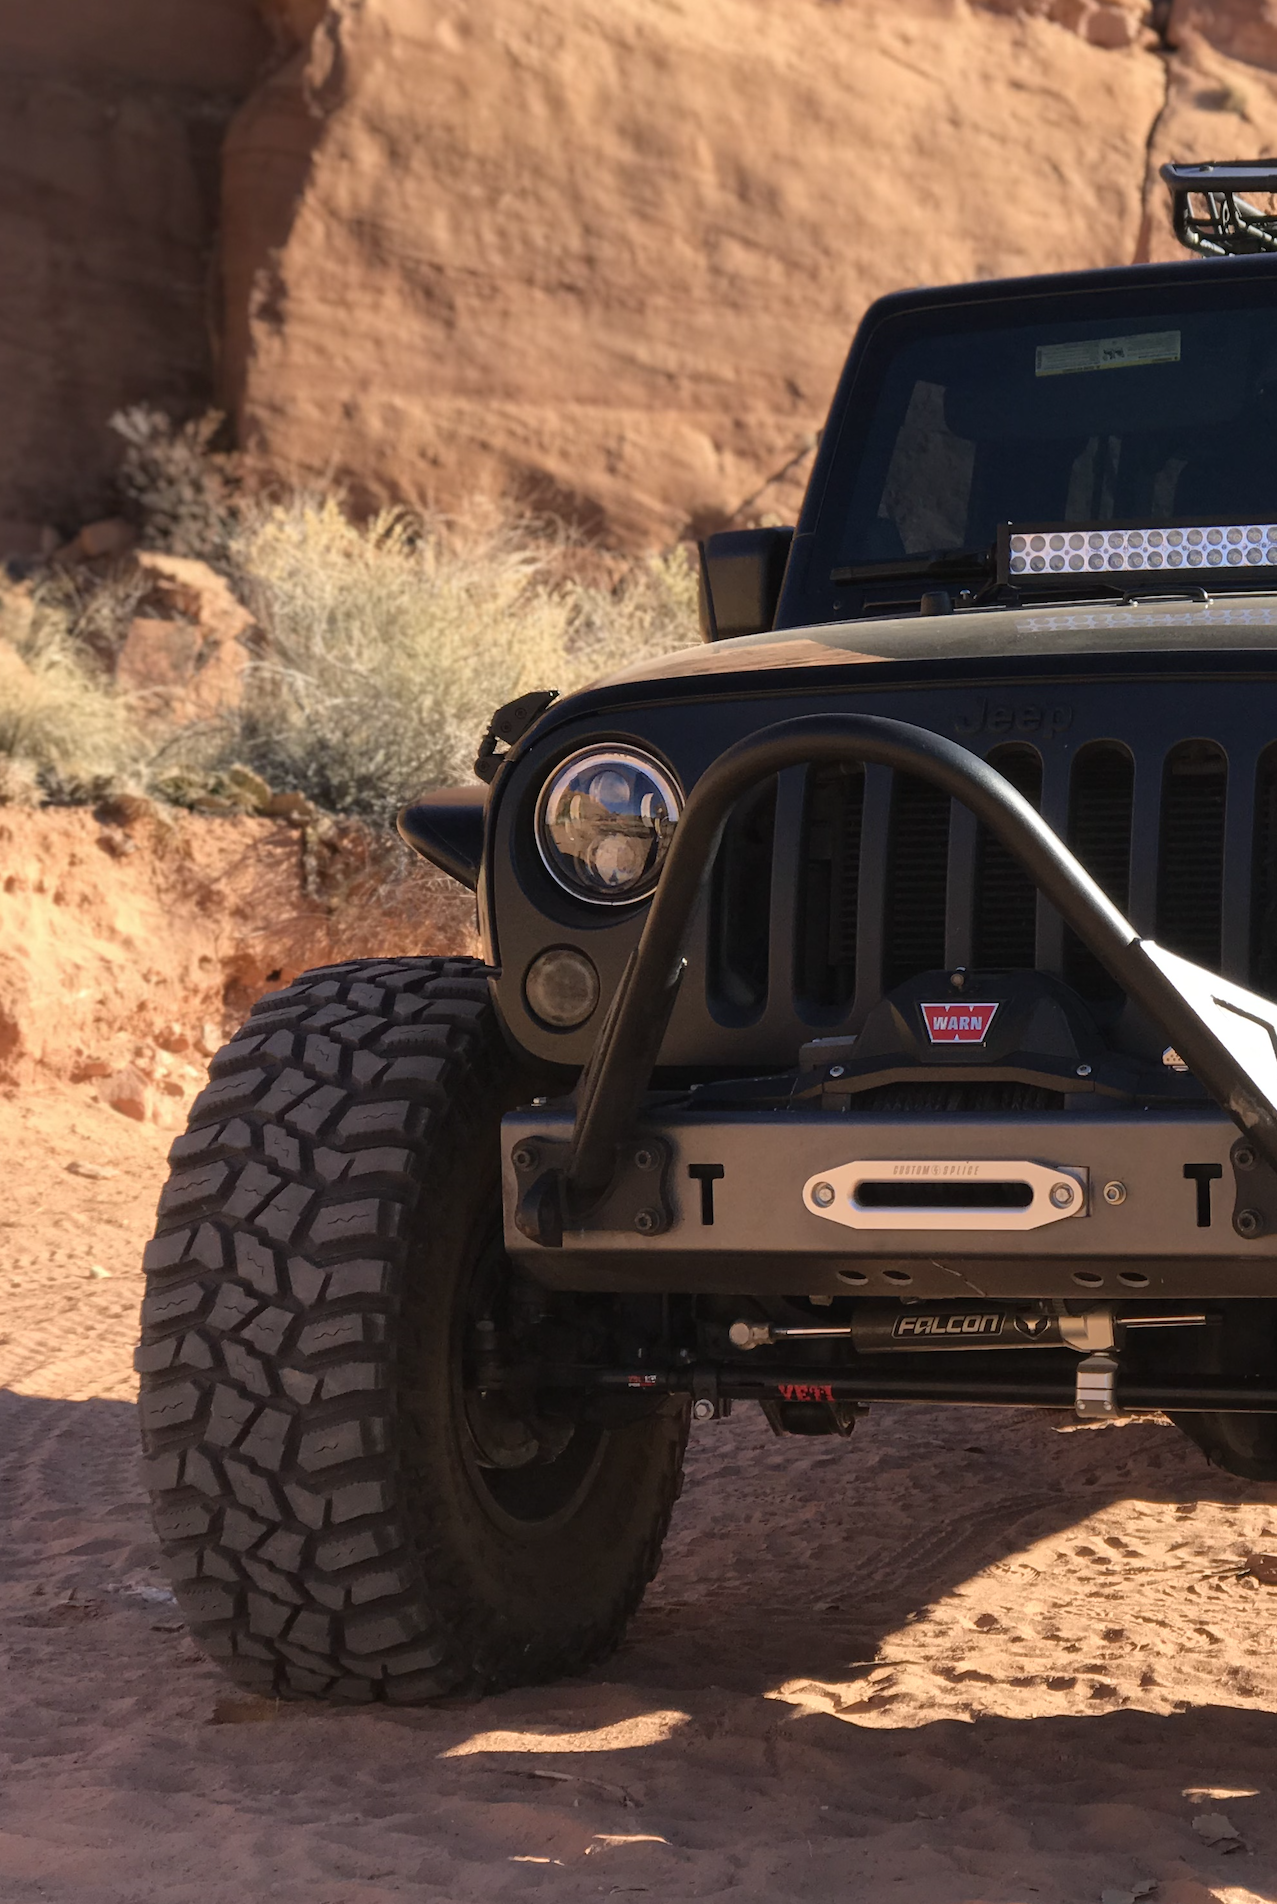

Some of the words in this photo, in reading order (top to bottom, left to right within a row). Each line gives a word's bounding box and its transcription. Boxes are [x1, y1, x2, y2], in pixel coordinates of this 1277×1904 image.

[954, 697, 1074, 739] Jeep
[932, 1016, 983, 1031] WARN
[893, 1165, 931, 1177] CUSTOM
[942, 1165, 980, 1176] SPLICE
[897, 1314, 1000, 1336] FALCON
[777, 1384, 837, 1403] YETI
